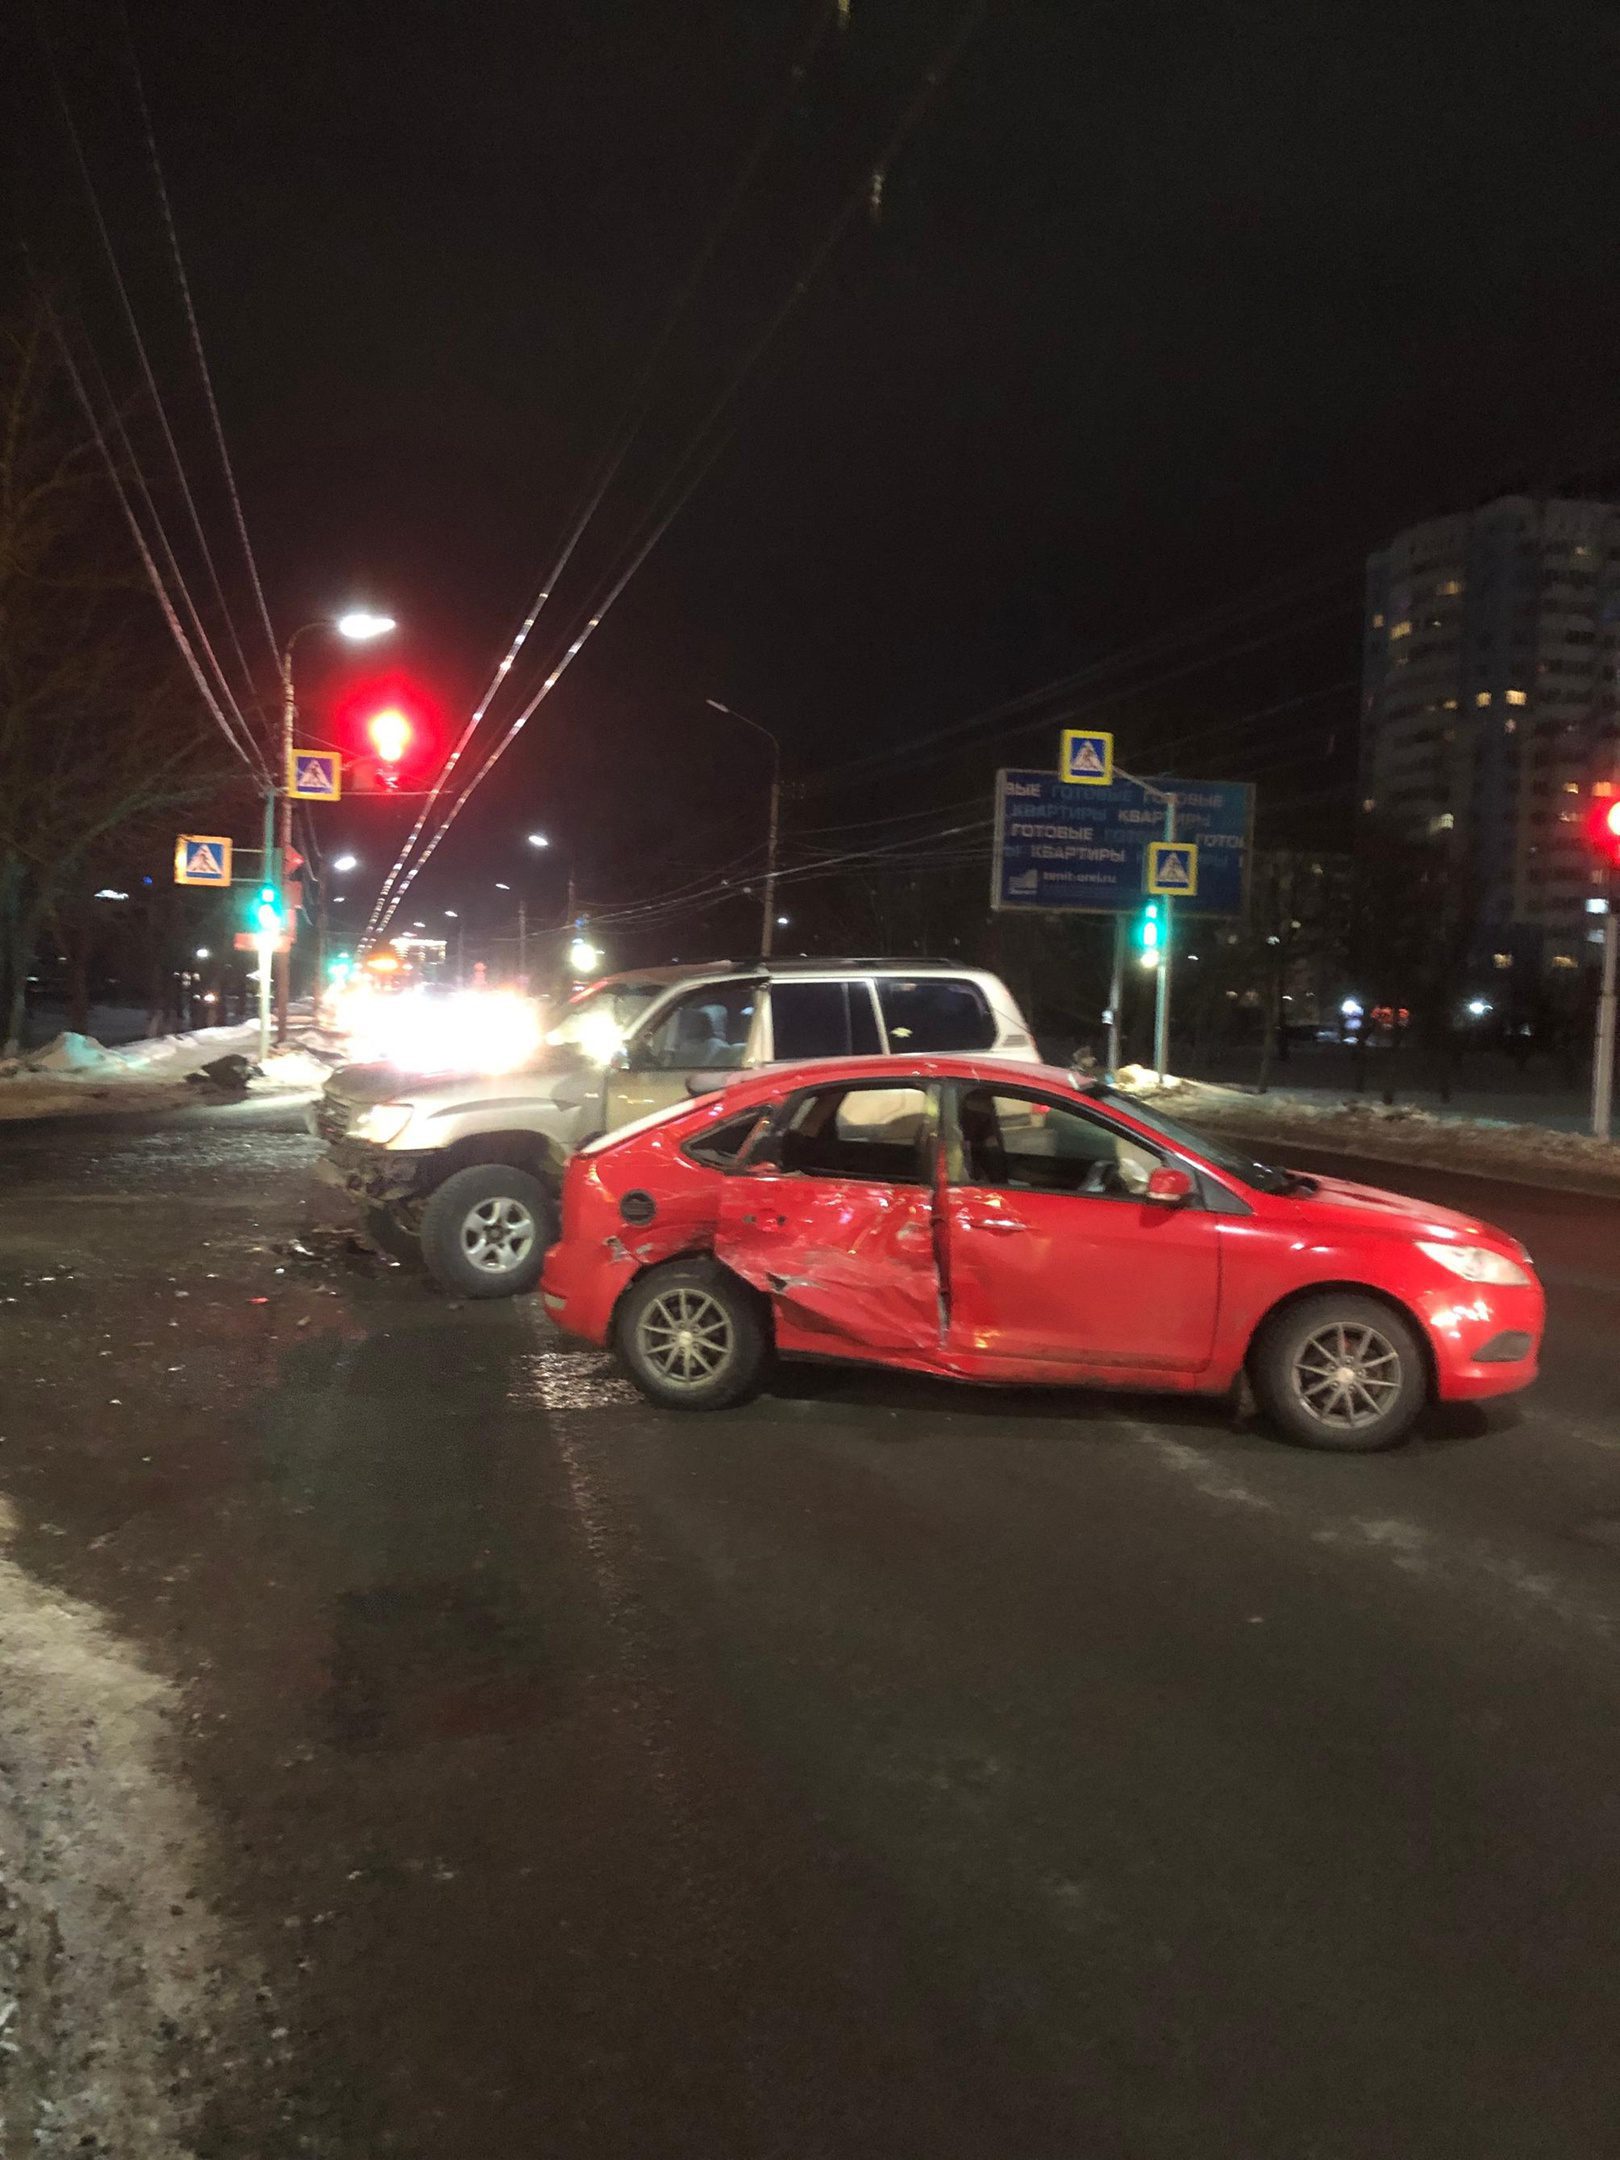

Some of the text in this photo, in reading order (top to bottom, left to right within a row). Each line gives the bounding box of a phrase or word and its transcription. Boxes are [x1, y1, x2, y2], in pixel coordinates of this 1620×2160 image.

[1118, 809, 1211, 827] КВАРИРЫ
[1011, 823, 1095, 840] ГОТОВЫЕ
[1030, 845, 1126, 863] КВАРТИРЫ
